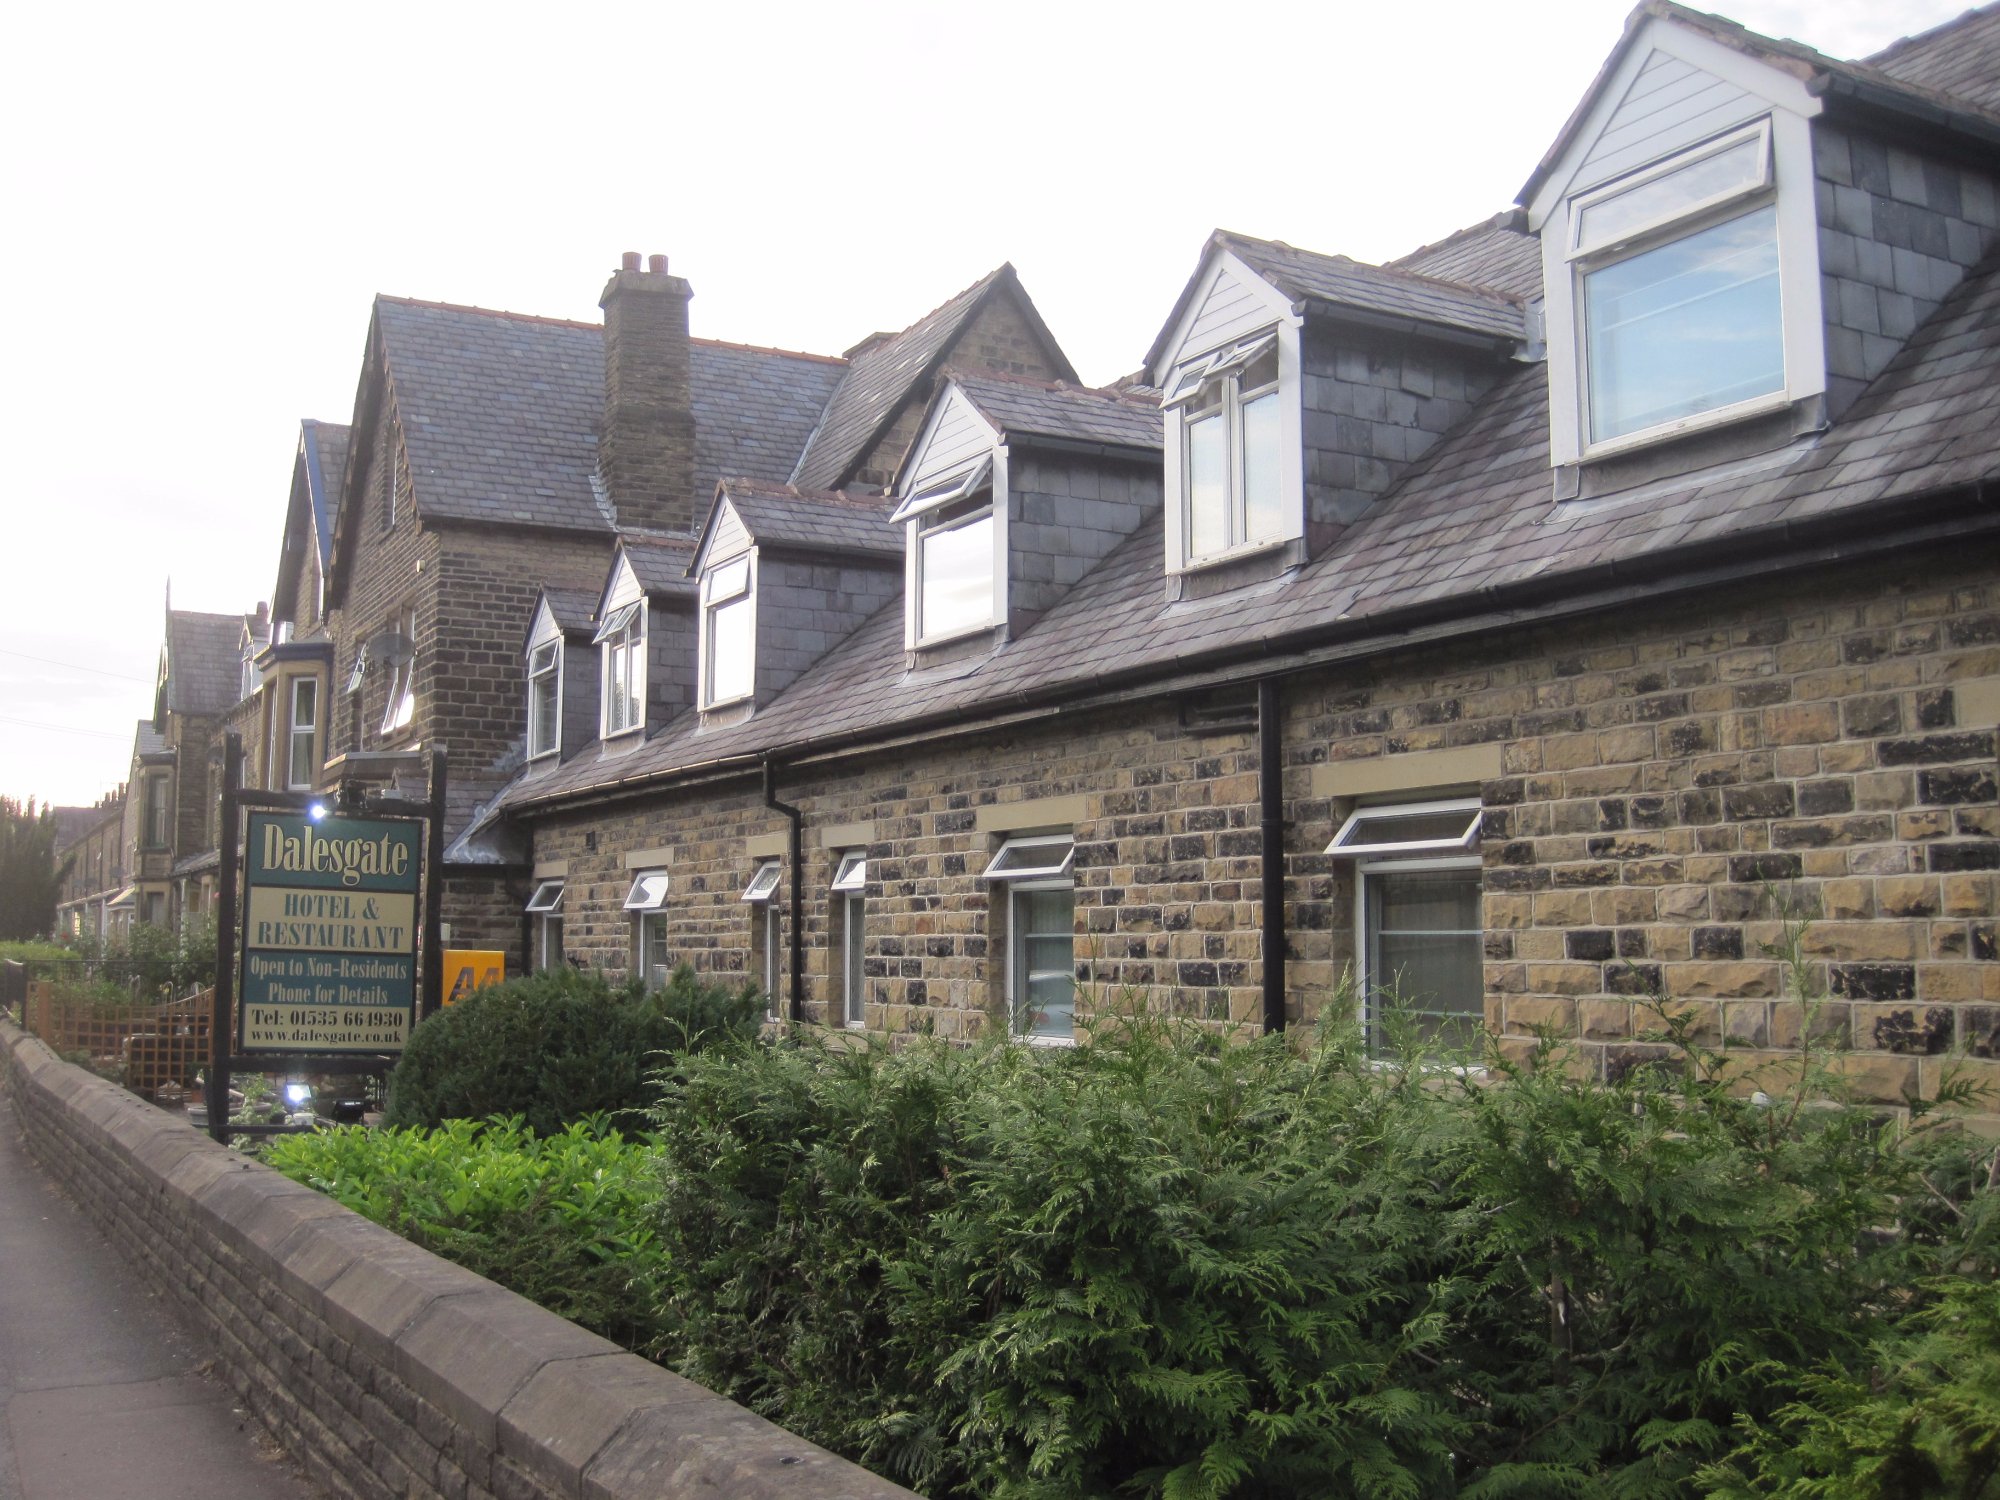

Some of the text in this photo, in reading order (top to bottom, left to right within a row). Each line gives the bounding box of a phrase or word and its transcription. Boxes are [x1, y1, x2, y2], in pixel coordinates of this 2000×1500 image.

[262, 824, 408, 886] Dalesgate
[284, 894, 379, 919] HOTEL &
[258, 922, 403, 949] RESTAURANT
[251, 956, 406, 979] Open to Non-Residents
[268, 983, 388, 1004] Phone for Details
[252, 1009, 403, 1027] Tel: 01535 664930
[252, 1029, 401, 1044] www.dalesgate.co.uk
